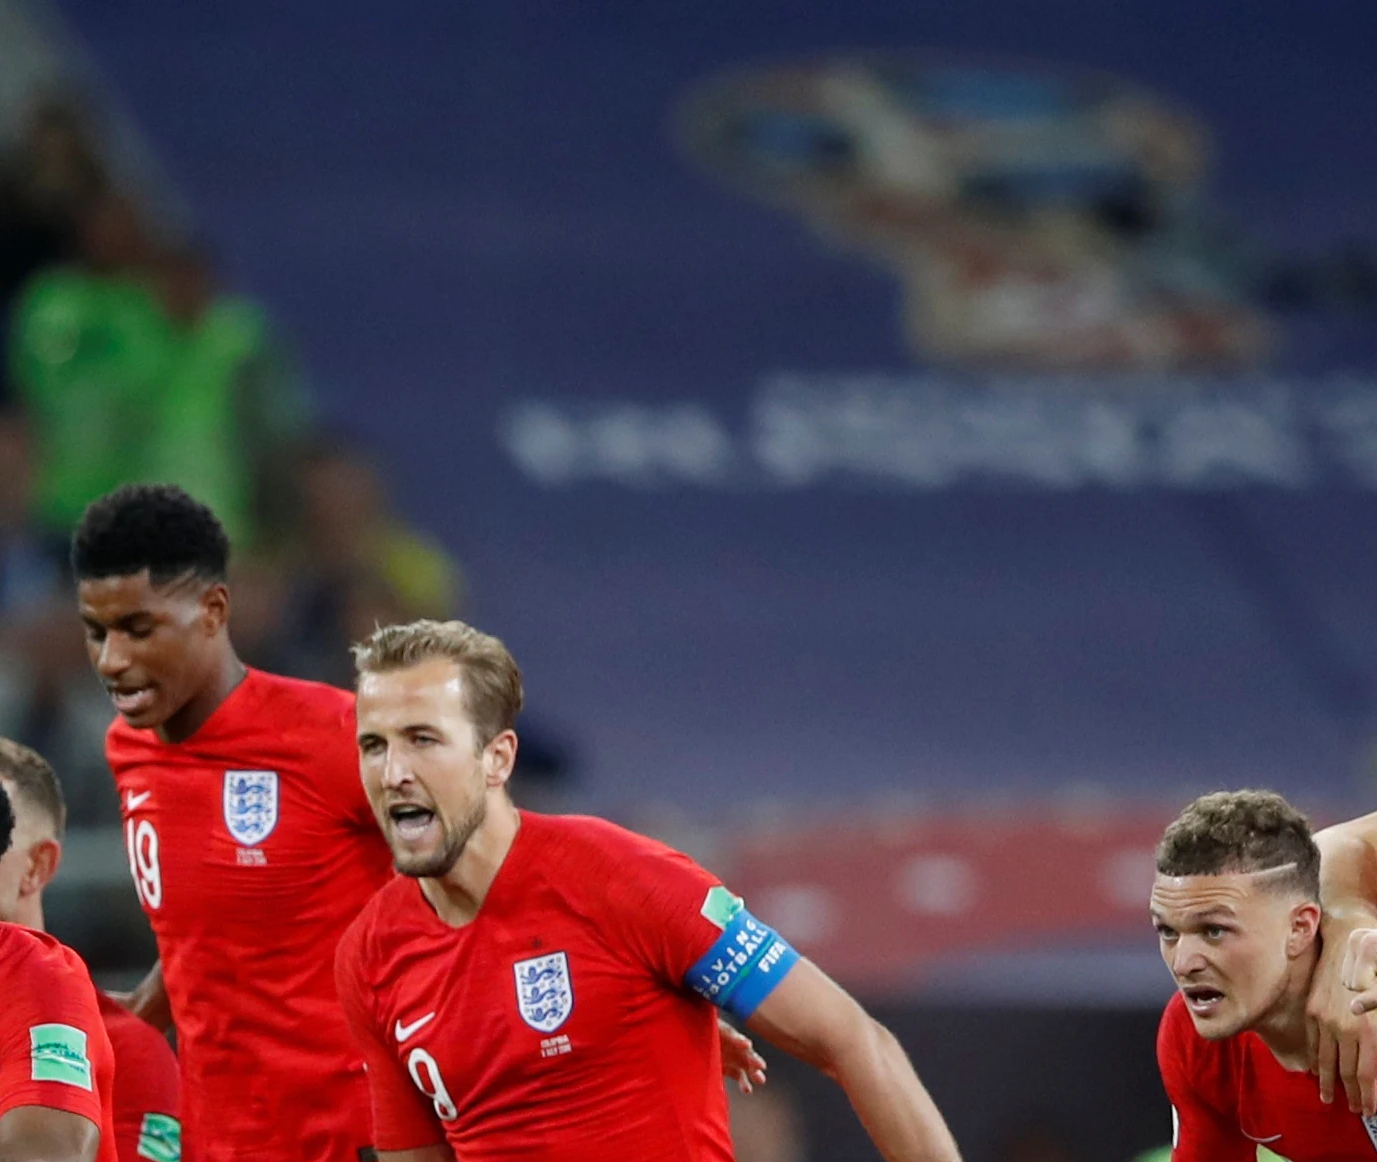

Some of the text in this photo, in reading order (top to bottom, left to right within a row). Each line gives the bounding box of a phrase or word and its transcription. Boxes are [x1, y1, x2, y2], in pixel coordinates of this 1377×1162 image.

[126, 817, 163, 910] 19
[757, 940, 787, 974] FIFA
[407, 1047, 459, 1122] 9
